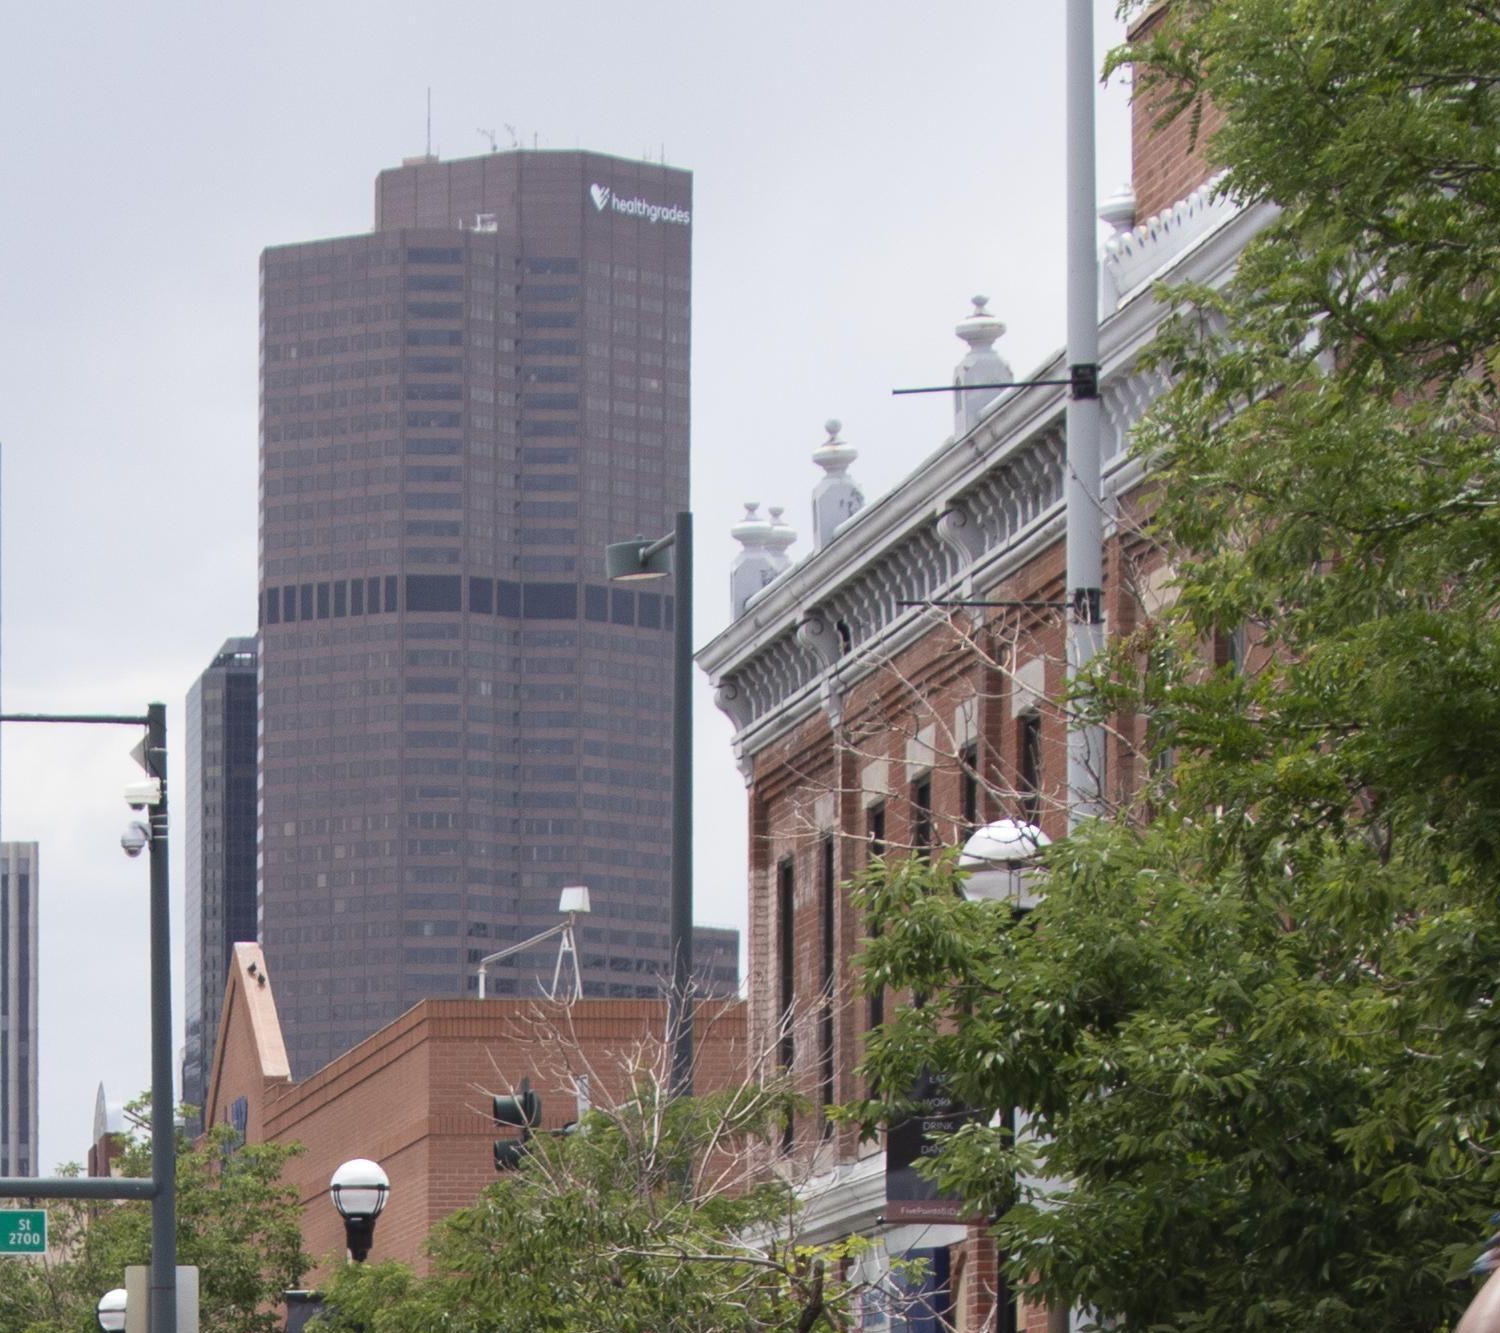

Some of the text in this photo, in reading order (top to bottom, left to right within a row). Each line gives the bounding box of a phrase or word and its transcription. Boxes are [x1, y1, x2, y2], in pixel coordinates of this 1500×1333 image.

[611, 193, 690, 224] healthgrades
[922, 1121, 954, 1131] DRINK
[18, 1219, 31, 1231] St
[9, 1232, 40, 1245] 2700
